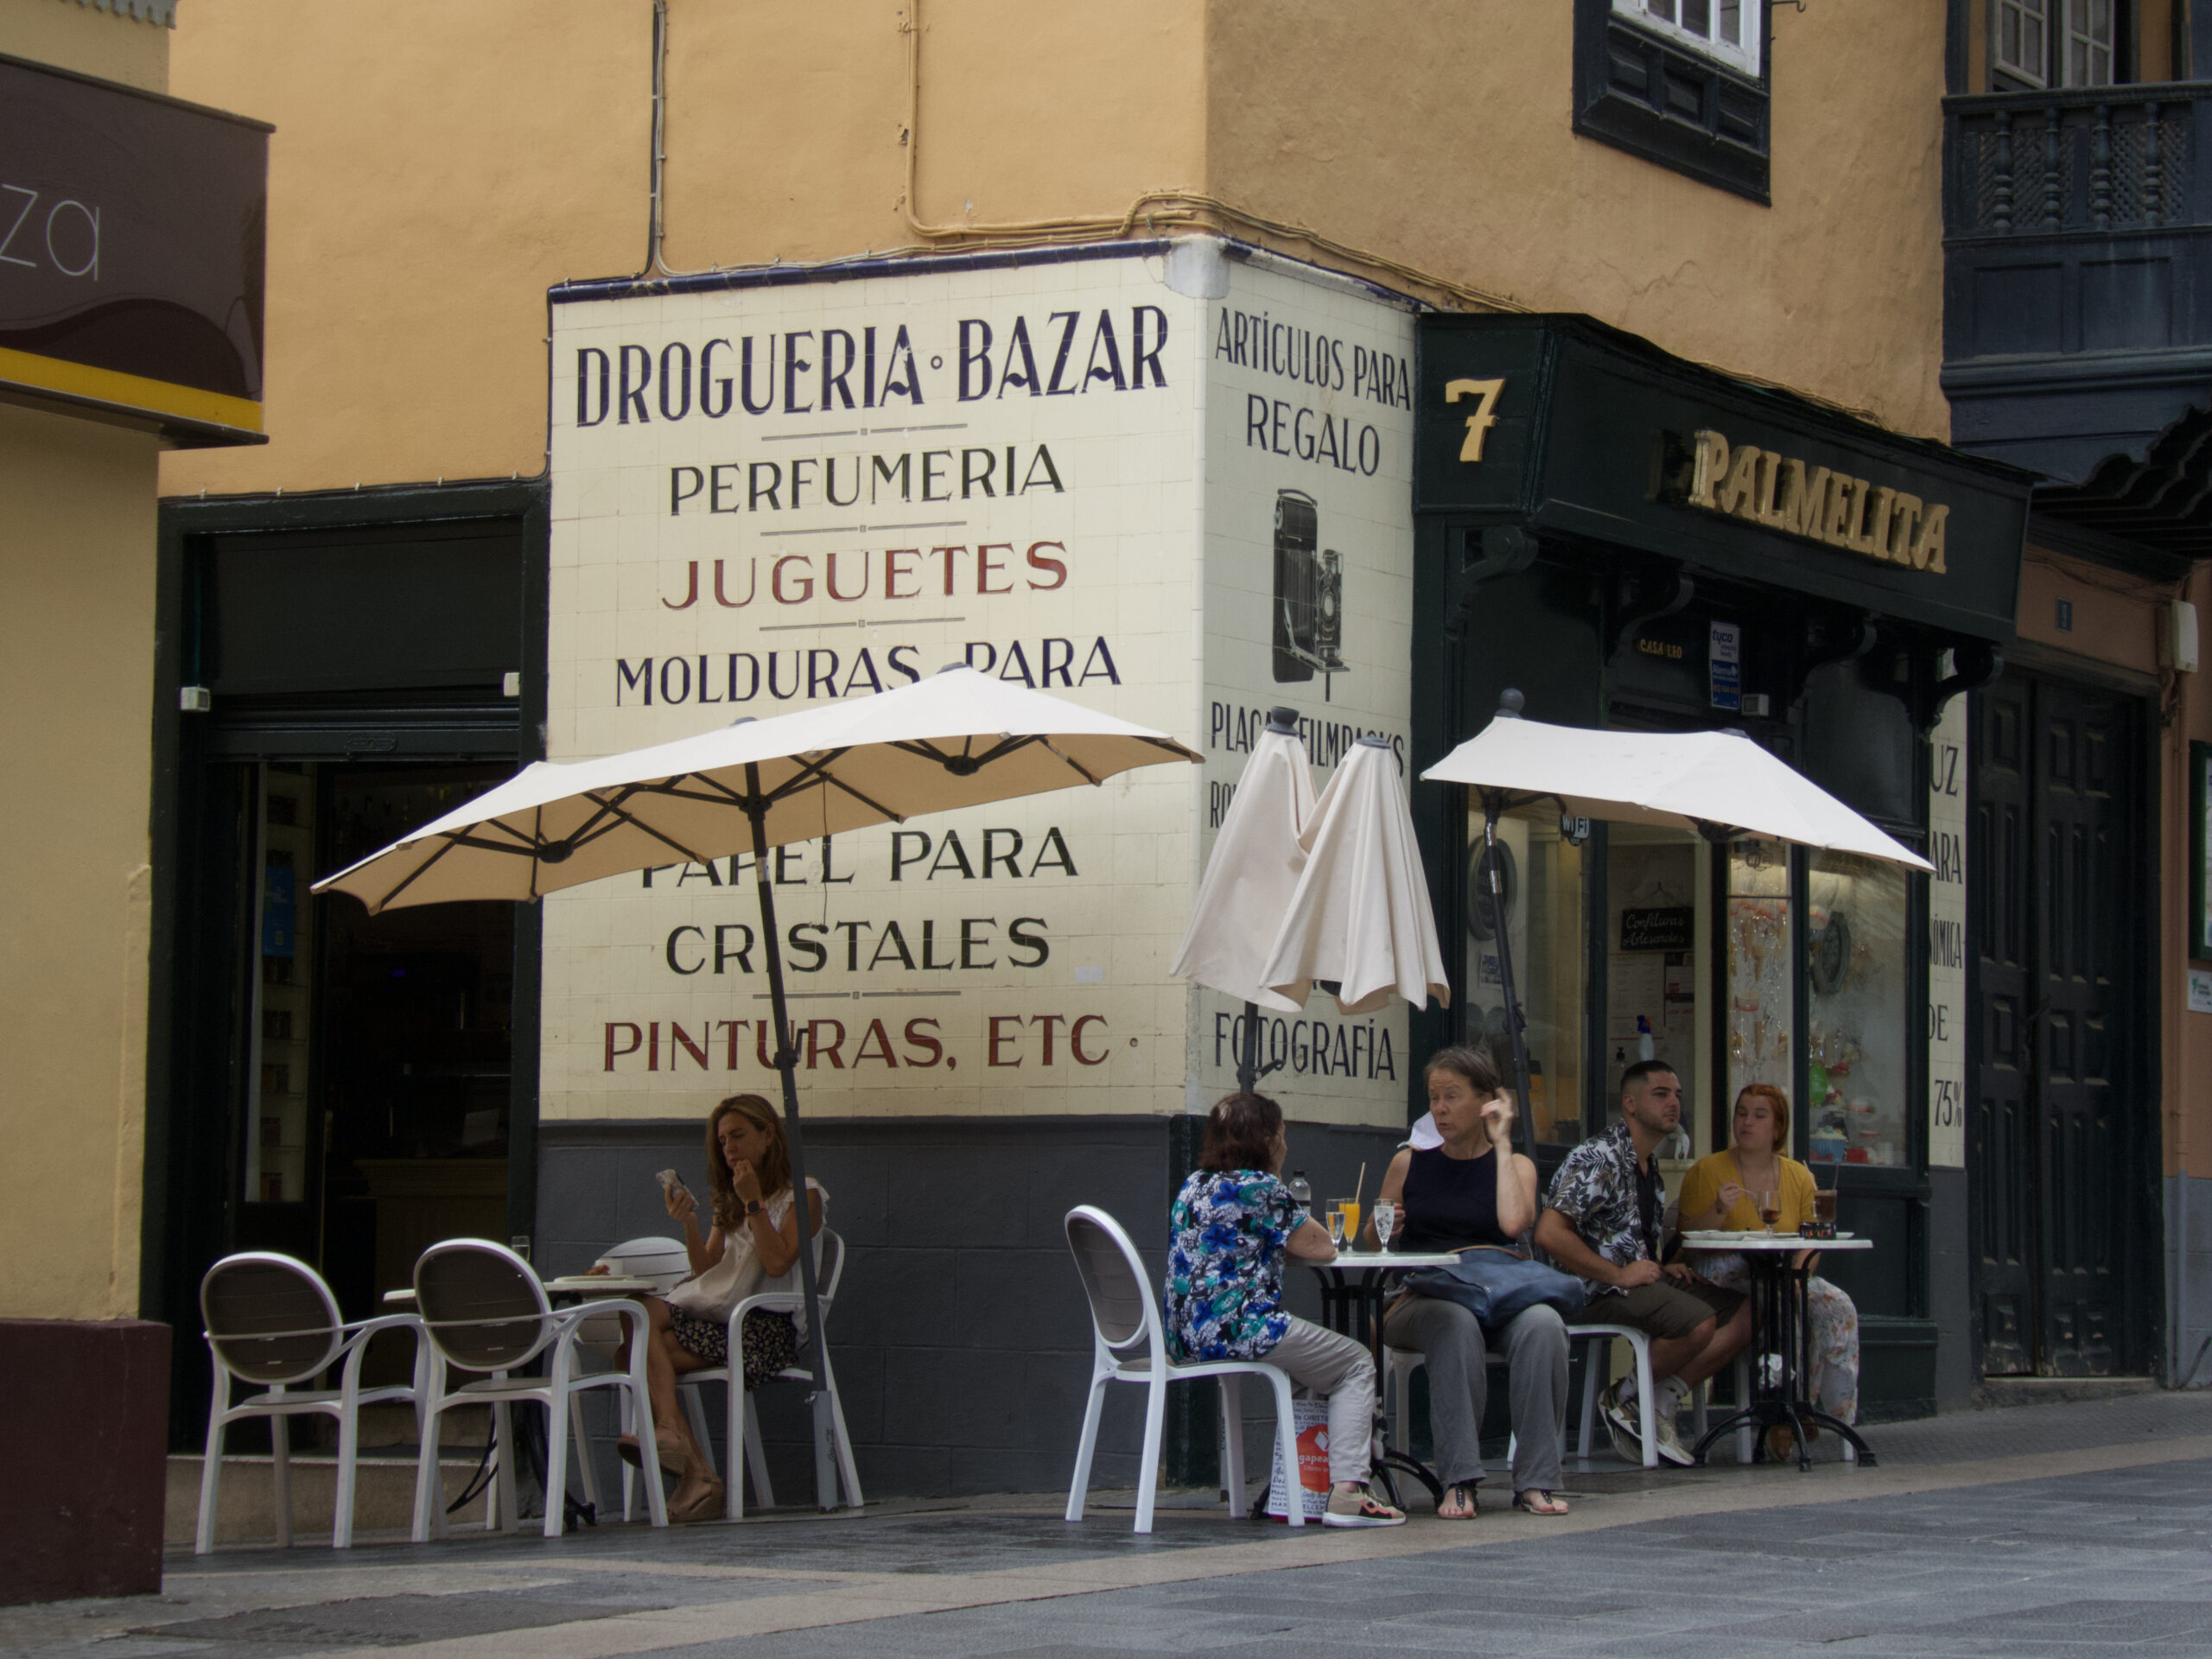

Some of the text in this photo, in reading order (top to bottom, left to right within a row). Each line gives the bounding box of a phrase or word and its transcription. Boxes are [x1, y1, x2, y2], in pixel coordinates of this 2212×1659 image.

[576, 305, 1169, 428] DROGUERIA BAZAR
[1215, 306, 1411, 411] ARTÍCULOS PARA
[1247, 392, 1381, 477] REGALO
[1446, 378, 1506, 463] 7
[670, 443, 1065, 517] PERFUMERIA
[1688, 427, 1950, 575] PALMELITA
[660, 540, 1069, 611] JUGUETES
[615, 636, 1122, 708] MOLDURAS PARA
[1713, 629, 1733, 645] tyco
[889, 826, 1079, 881] PARA
[665, 916, 1052, 976] CRSTALES
[987, 1014, 1110, 1069] ETC
[1935, 1079, 1962, 1128] 75%
[1299, 1454, 1329, 1465] gapea
